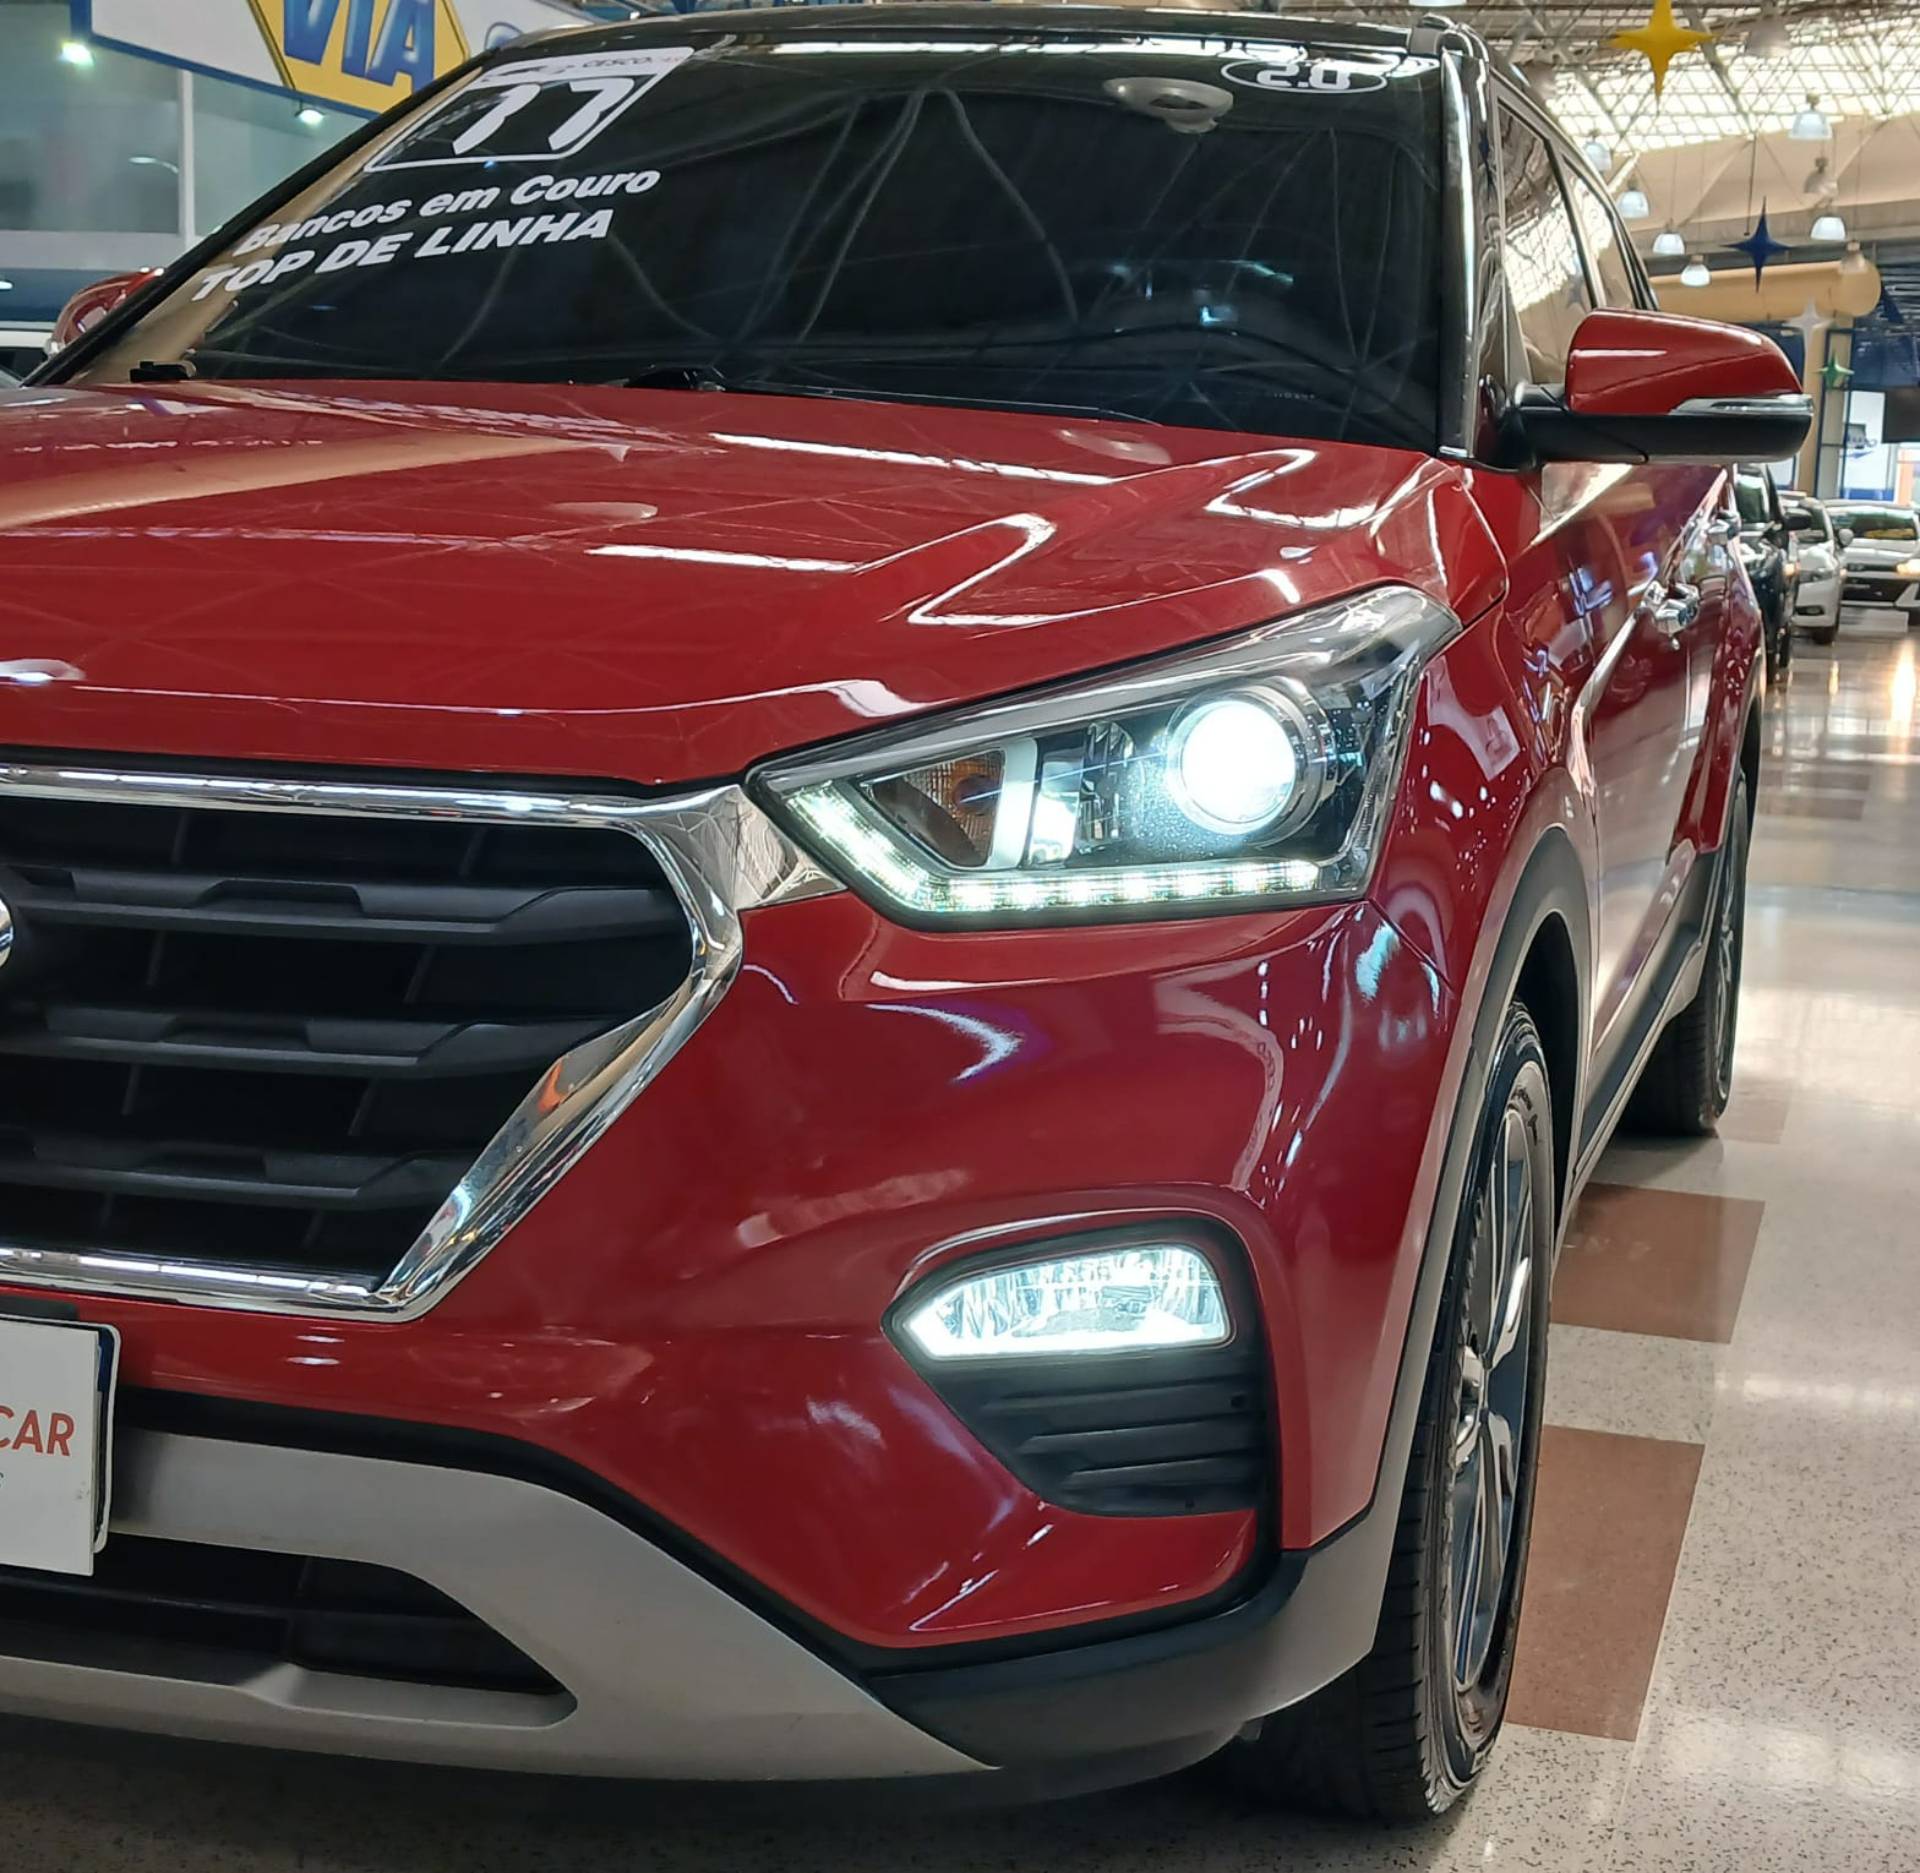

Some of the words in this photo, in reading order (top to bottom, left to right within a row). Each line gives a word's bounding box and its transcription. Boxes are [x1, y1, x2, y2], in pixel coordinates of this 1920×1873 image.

[283, 0, 436, 95] VIA
[191, 250, 314, 301] TOP
[314, 232, 414, 274] DE
[413, 209, 614, 258] LINHA
[233, 198, 408, 257] Bancos
[418, 185, 500, 217] em
[510, 169, 661, 206] Couro
